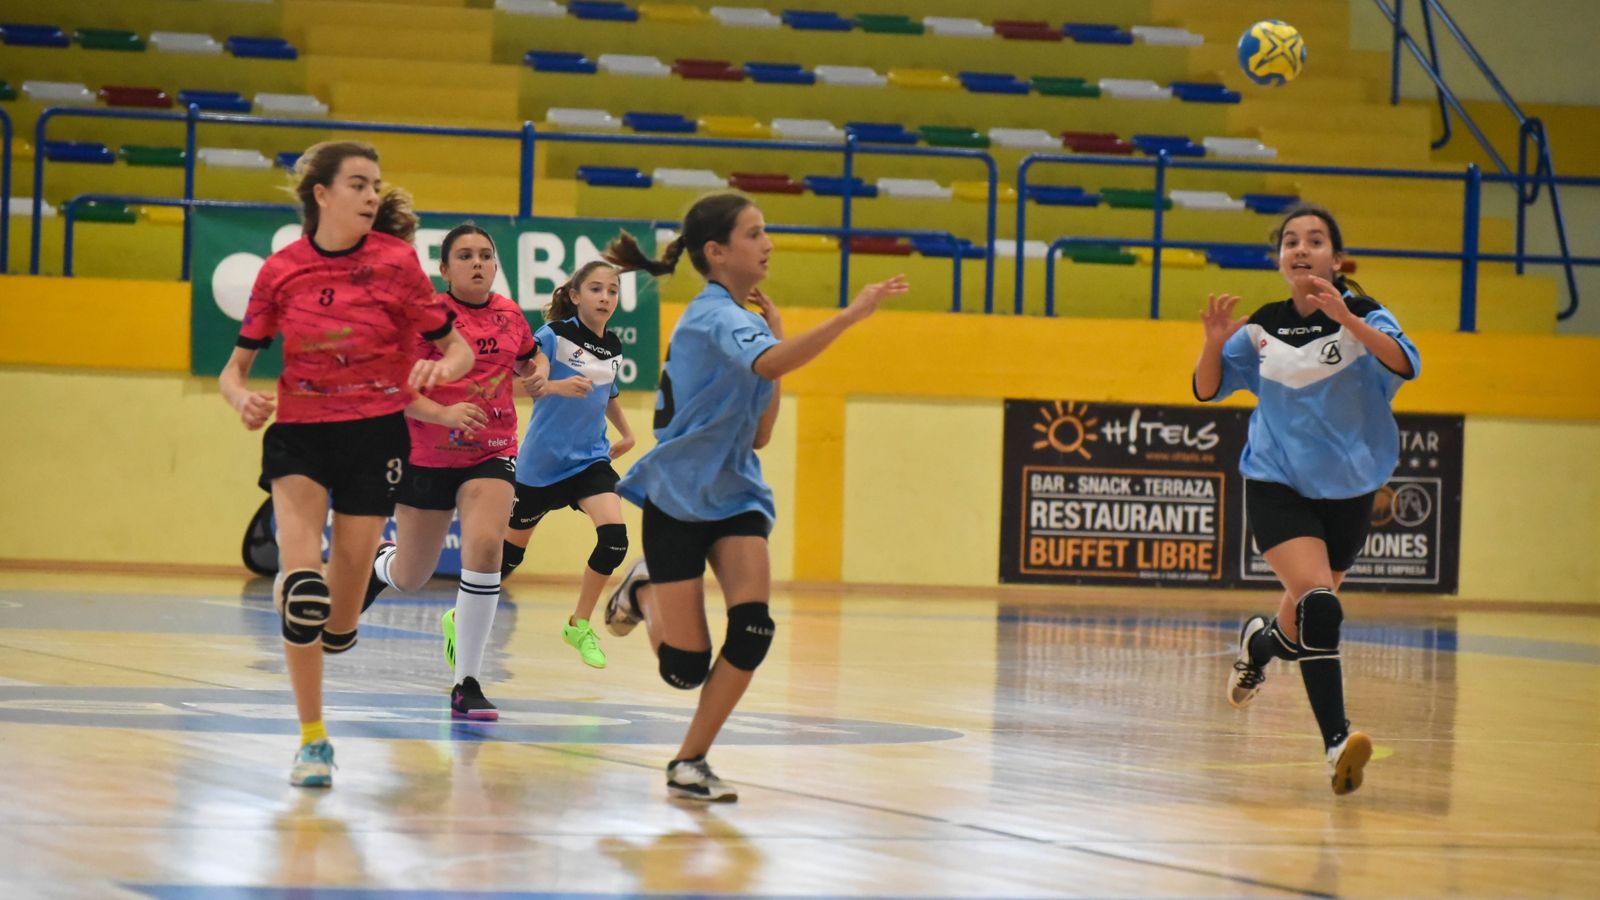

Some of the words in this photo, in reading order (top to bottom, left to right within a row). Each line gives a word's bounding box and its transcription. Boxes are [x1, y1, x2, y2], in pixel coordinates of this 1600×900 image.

[319, 287, 336, 307] 3
[475, 337, 500, 355] 22
[386, 457, 402, 484] 3
[1031, 474, 1065, 493] BAR
[1077, 476, 1131, 495] SNACK
[1144, 478, 1214, 498] TERRAZA
[1031, 500, 1215, 534] RESTAURANTE
[1029, 537, 1130, 567] BUFFET
[1136, 541, 1214, 571] LIBRE
